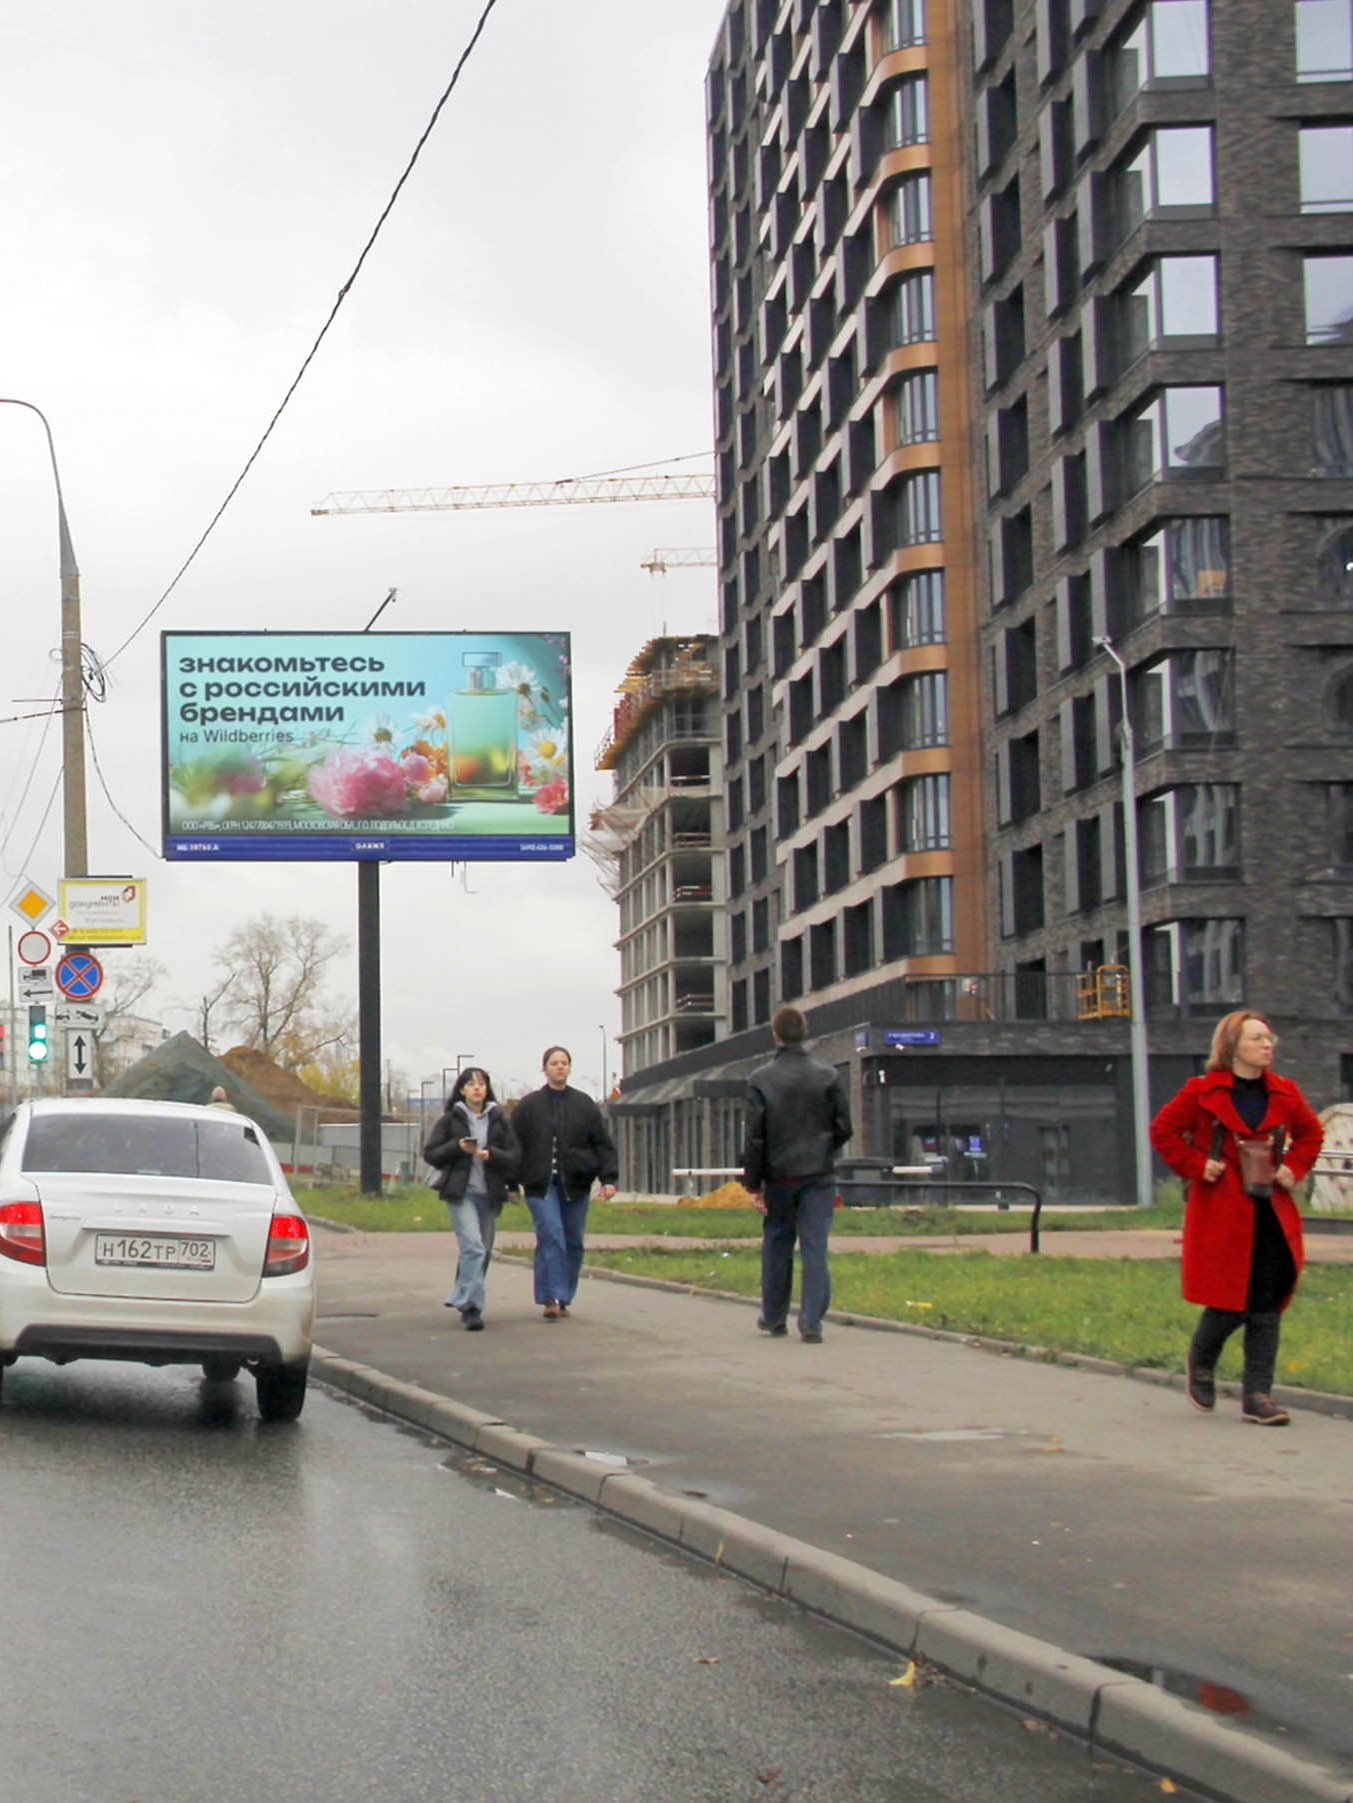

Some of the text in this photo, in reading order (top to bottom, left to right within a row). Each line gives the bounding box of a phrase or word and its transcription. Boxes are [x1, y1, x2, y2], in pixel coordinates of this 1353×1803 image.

[179, 656, 385, 673] знакомьтесь
[179, 676, 426, 701] с российскими
[180, 702, 344, 725] брендами
[179, 729, 294, 743] на Wildberries
[114, 1200, 200, 1216] LADA
[181, 1241, 209, 1258] 702
